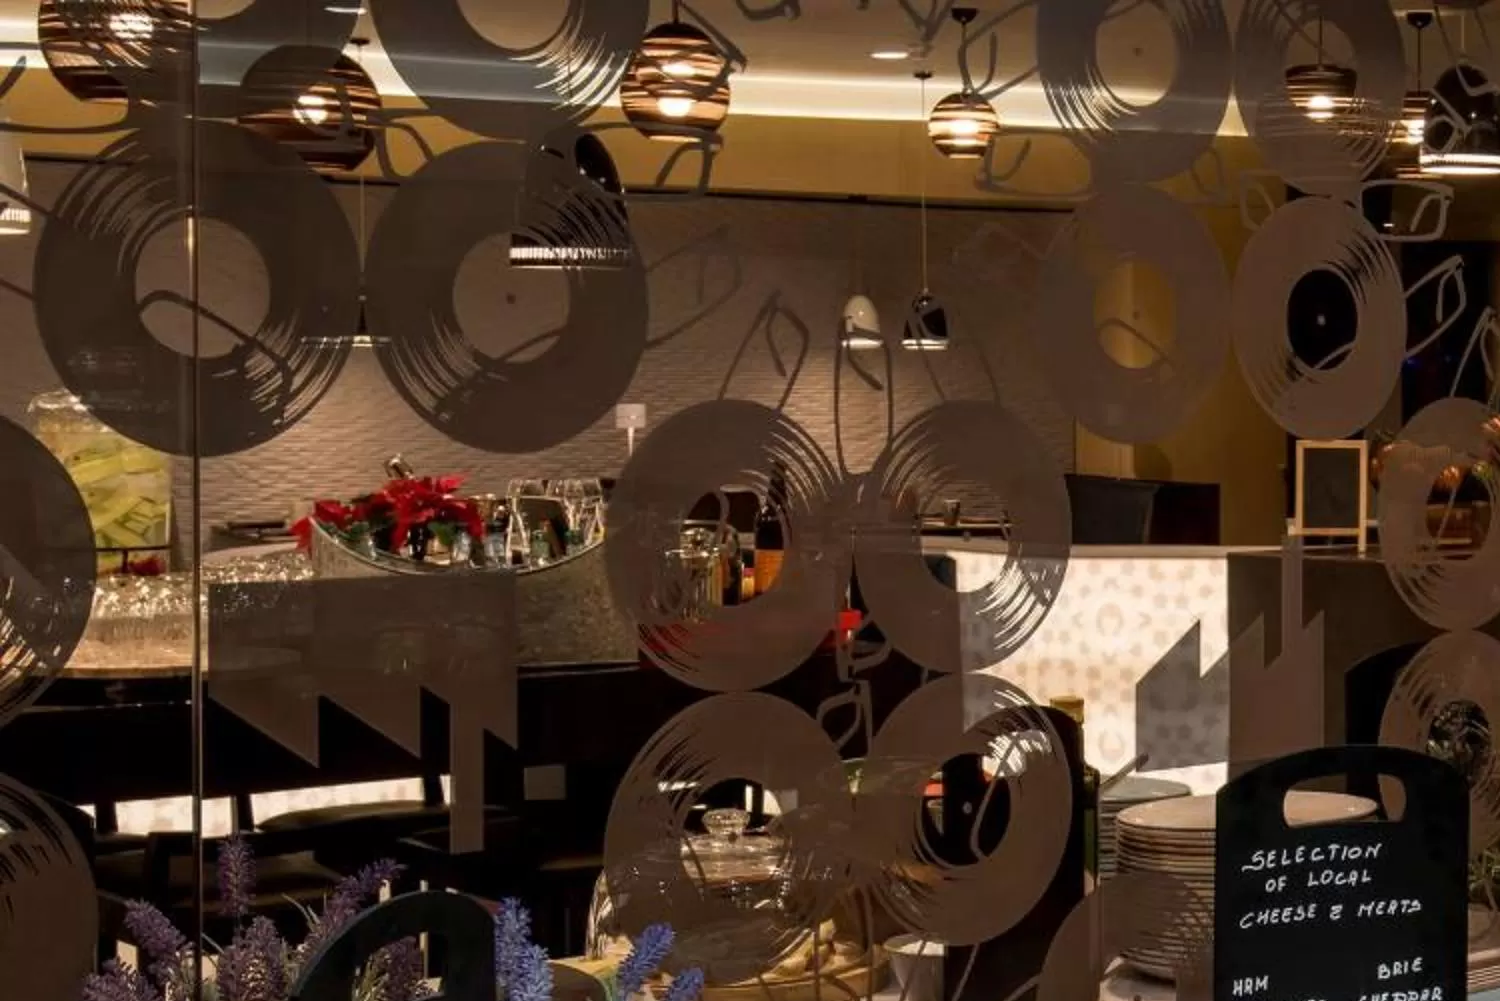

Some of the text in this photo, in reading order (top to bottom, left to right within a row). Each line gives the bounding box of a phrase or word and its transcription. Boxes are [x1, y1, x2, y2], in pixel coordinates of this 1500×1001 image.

[1241, 843, 1382, 872] SELECTION
[1266, 870, 1371, 892] OF LOCAL
[1240, 904, 1316, 928] CHEESE
[1358, 900, 1421, 916] MEATS
[1378, 957, 1422, 979] BRIE
[1233, 976, 1268, 996] HAM
